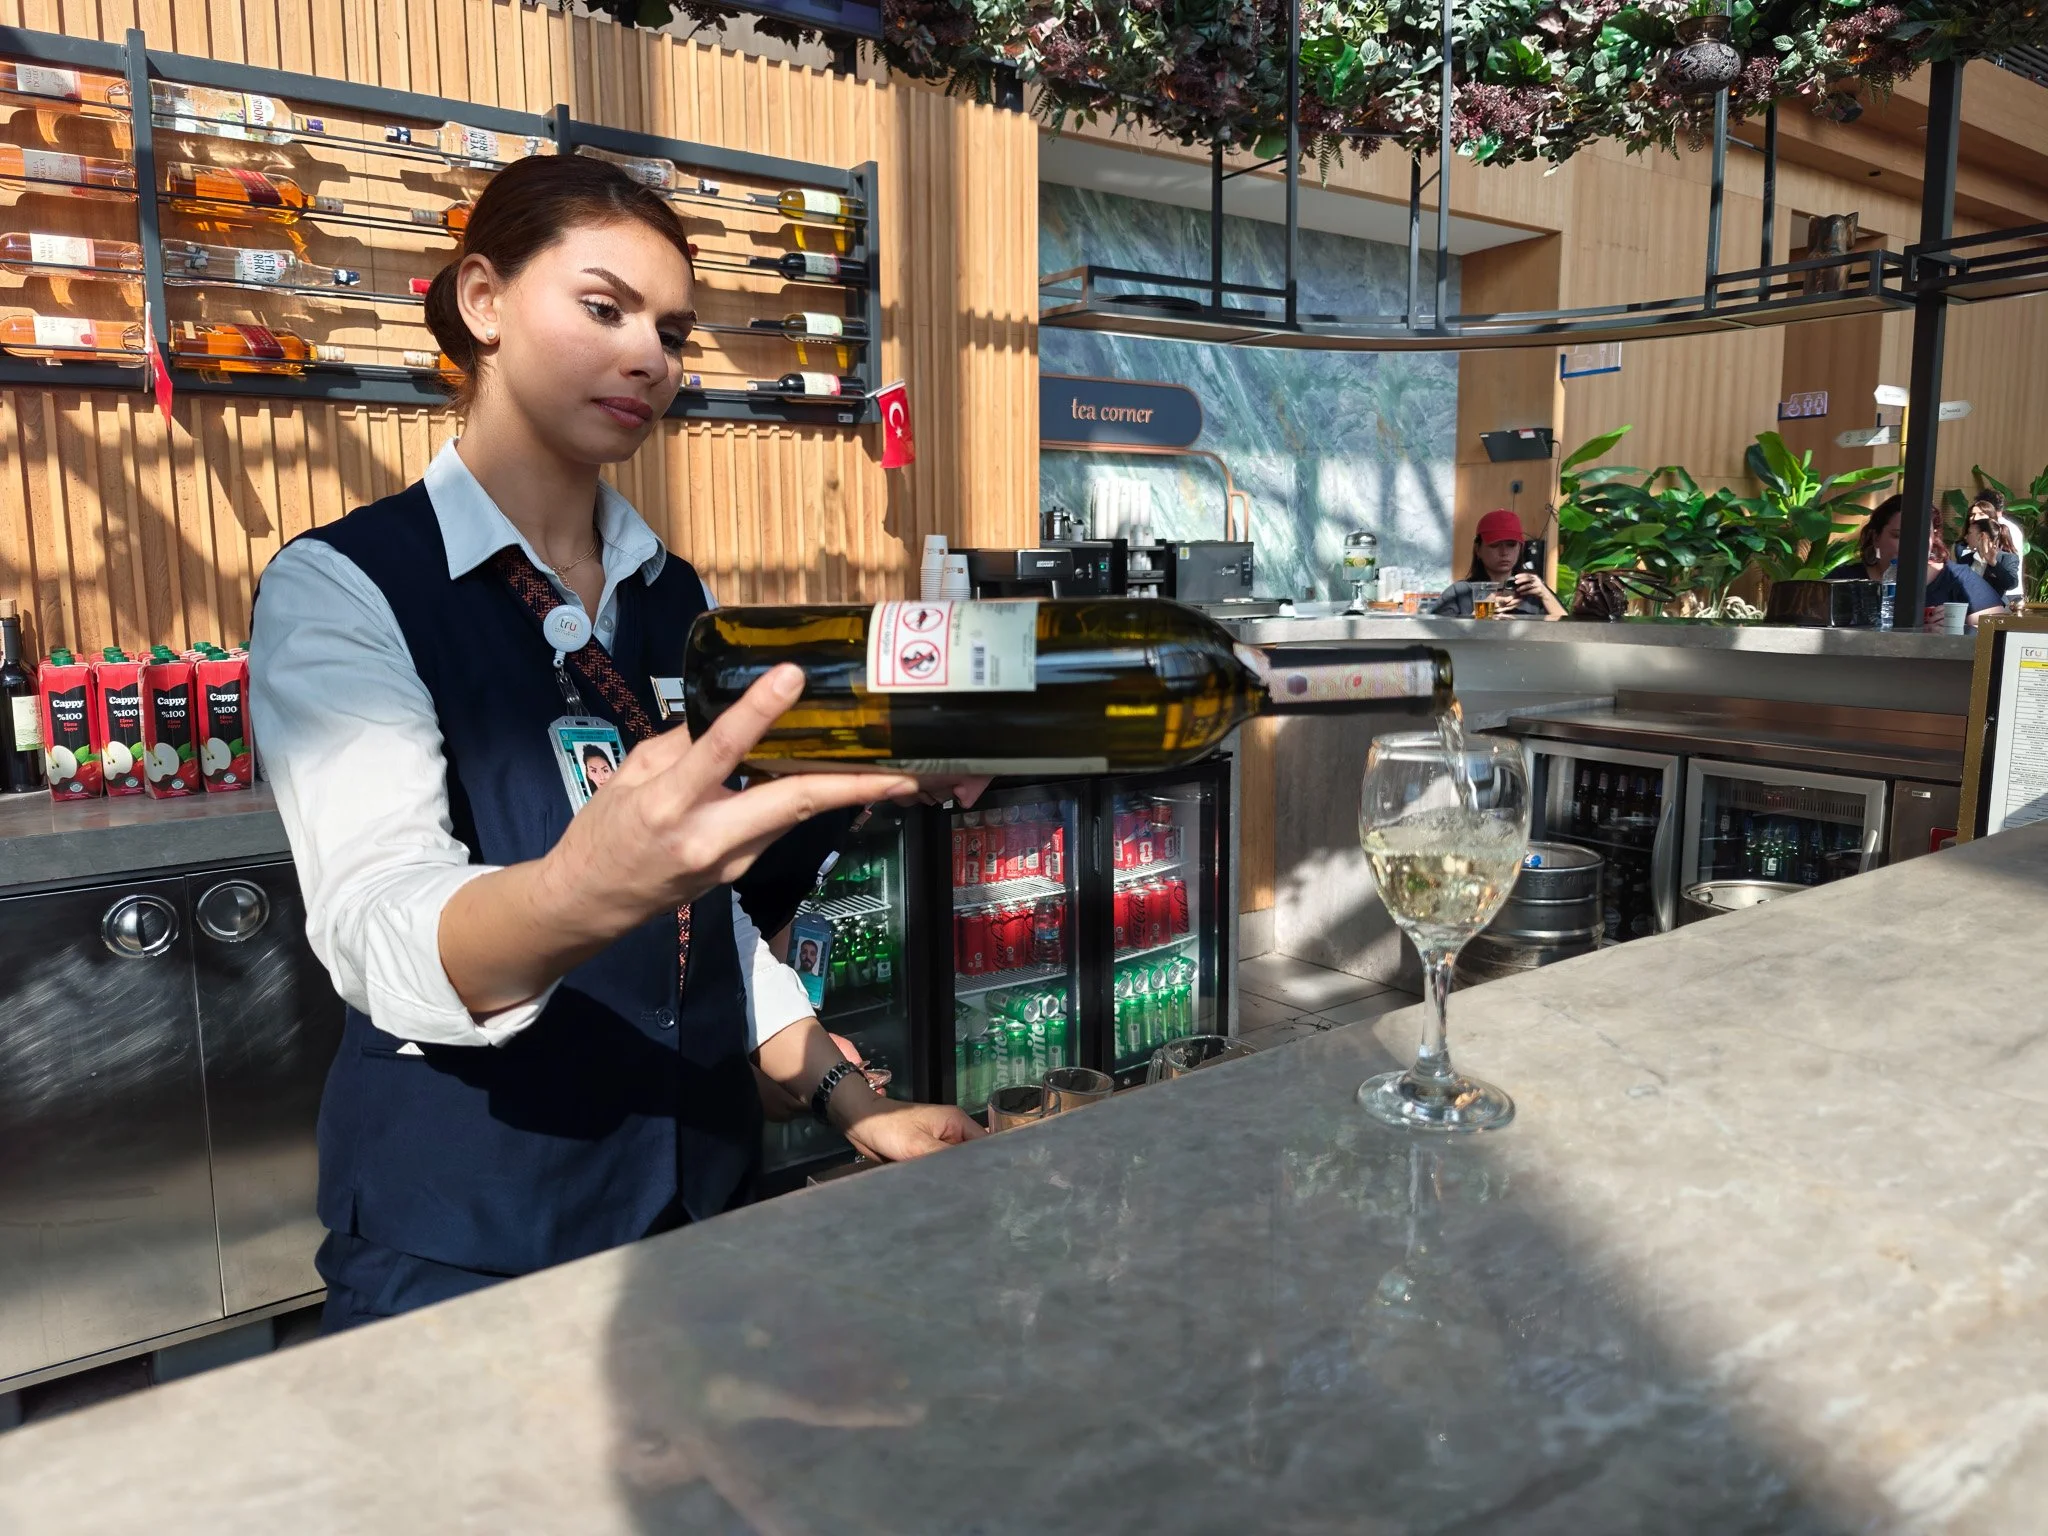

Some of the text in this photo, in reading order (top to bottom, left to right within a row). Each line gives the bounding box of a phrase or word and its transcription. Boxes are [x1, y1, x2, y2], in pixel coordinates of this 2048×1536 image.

[1071, 398, 1154, 424] tea corner
[560, 618, 577, 632] tru
[2025, 648, 2043, 657] tru
[108, 696, 140, 705] Cappy
[157, 697, 187, 706] Cappy
[209, 693, 239, 702] Cappy
[52, 700, 84, 709] Cappy
[113, 709, 138, 717] %100
[161, 710, 186, 718] %100
[213, 705, 238, 714] %100
[56, 712, 83, 720] %100
